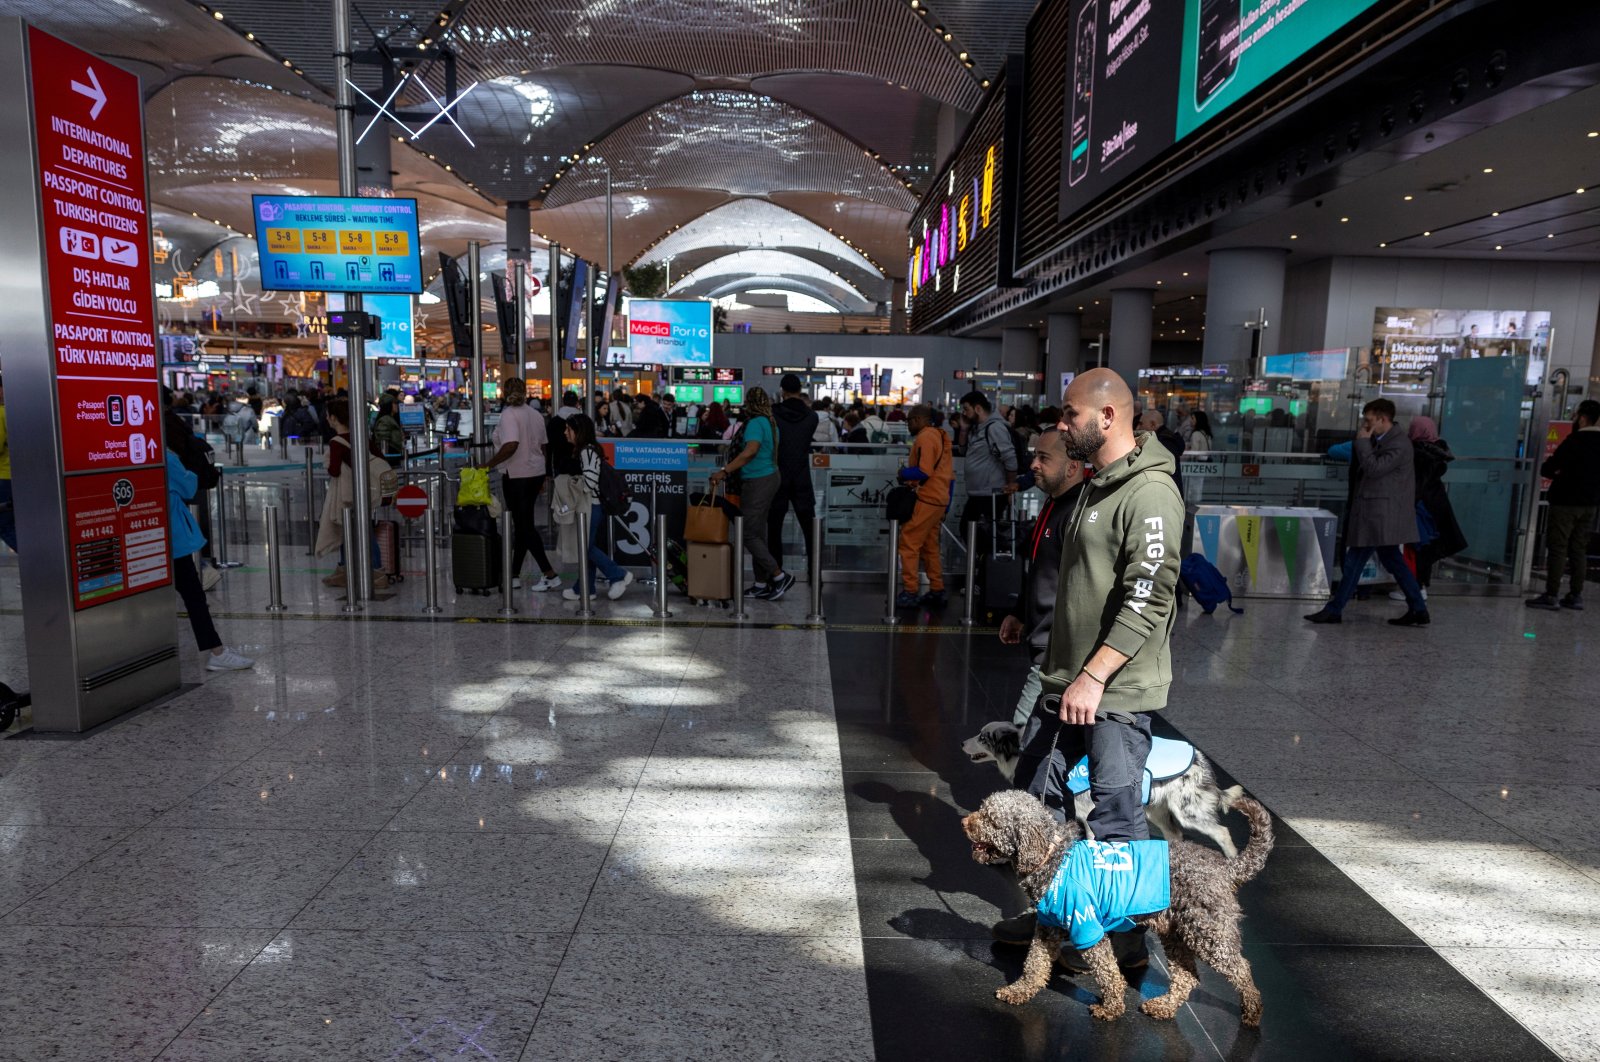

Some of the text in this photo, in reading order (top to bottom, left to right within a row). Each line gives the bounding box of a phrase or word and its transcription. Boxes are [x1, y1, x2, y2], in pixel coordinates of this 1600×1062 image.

[51, 116, 132, 159] INTERNATIONAL
[62, 144, 127, 180] DEPARTURES
[44, 171, 145, 214] PASSPORT CONTROL
[384, 205, 412, 214] CONTROL
[54, 199, 138, 235] TURKISH CITIZENS
[296, 214, 324, 223] BEKLEME
[352, 215, 378, 223] WAITING
[379, 216, 394, 224] TIME
[277, 231, 291, 242] 5-8
[312, 232, 327, 242] 5-8
[348, 233, 363, 243] 5-8
[384, 234, 399, 244] 5-8
[73, 267, 130, 291] DIŞ HATLAR
[73, 290, 137, 315] GİDEN YOLCU
[55, 324, 154, 348] PASAPORT KONTROL
[631, 323, 696, 337] Media Port
[1391, 343, 1439, 353] Discover
[58, 344, 154, 370] TÜRK VATANDAŞLARI
[1391, 353, 1438, 363] premium
[77, 400, 105, 411] e-Pasaport
[76, 410, 105, 421] e-Passports
[105, 440, 128, 450] Diplomat
[616, 446, 687, 455] TÜRK VATANDAŞLARI
[88, 452, 115, 462] Diplomatic
[115, 486, 132, 500] SOS
[130, 519, 142, 530] 444
[148, 516, 159, 526] 442
[616, 502, 650, 555] 3
[81, 528, 94, 539] 444
[100, 525, 114, 534] 442
